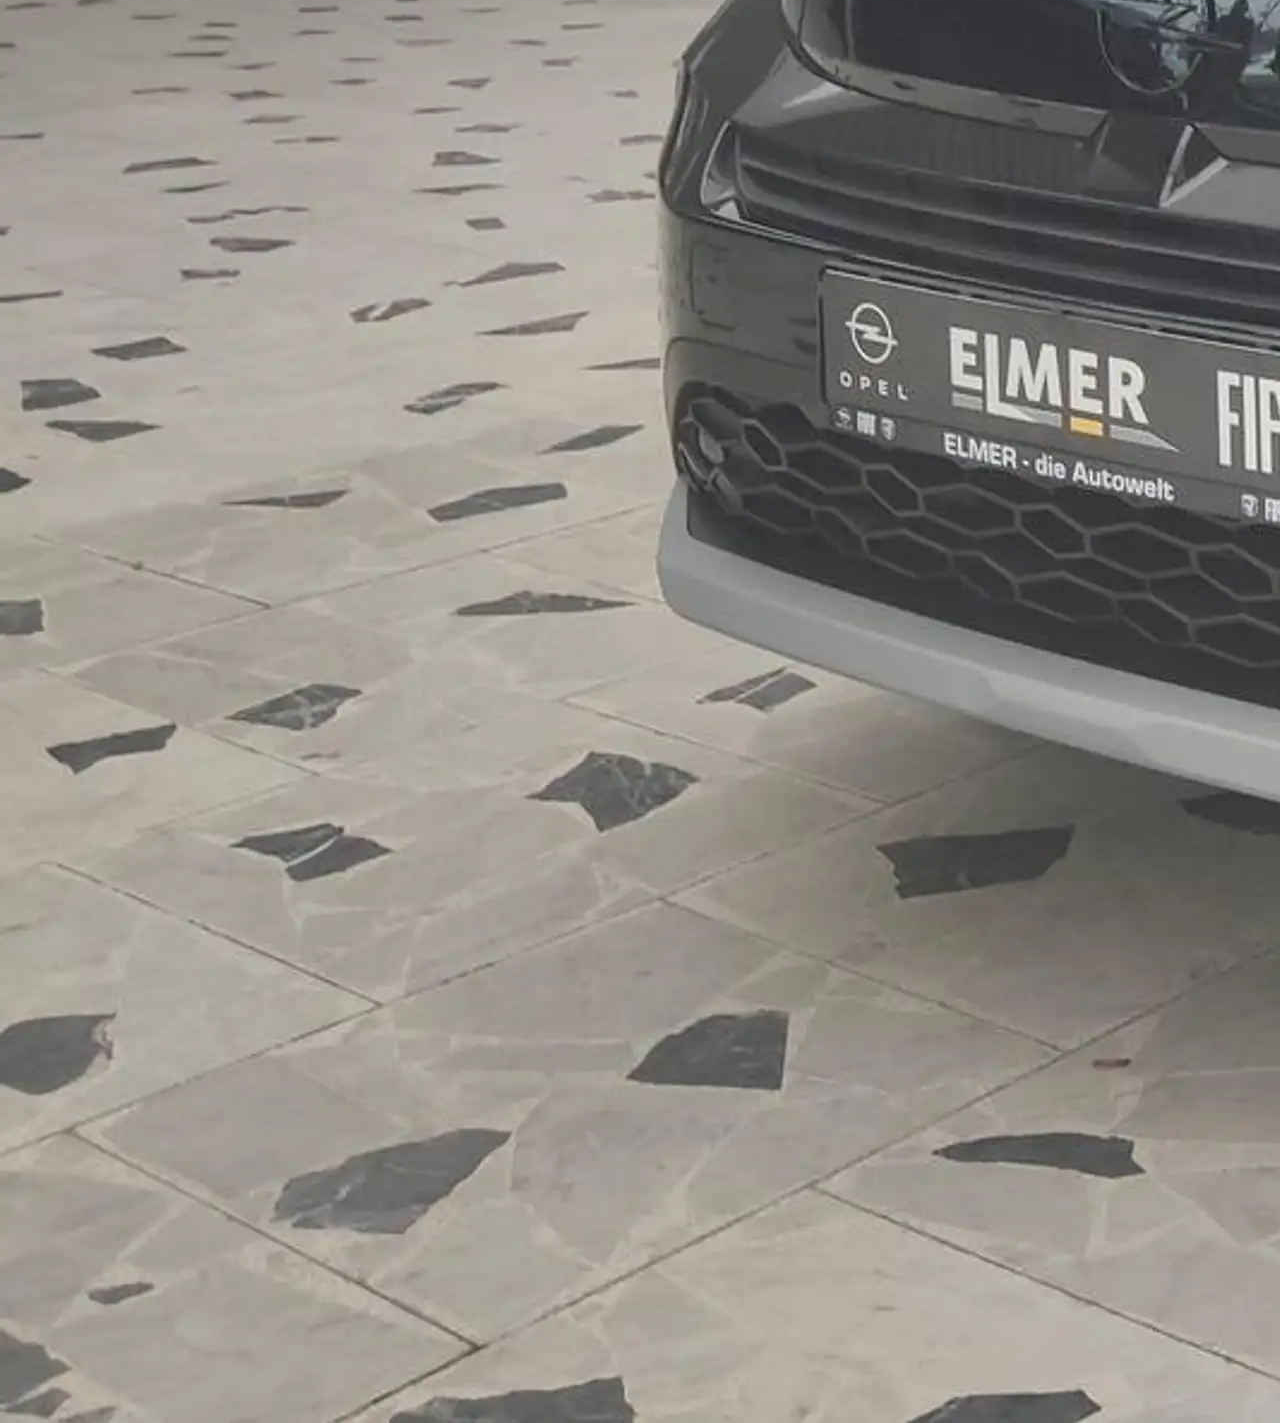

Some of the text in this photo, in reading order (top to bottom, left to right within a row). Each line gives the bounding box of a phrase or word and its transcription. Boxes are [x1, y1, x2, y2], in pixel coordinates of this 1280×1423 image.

[839, 370, 909, 402] OPEL
[949, 326, 1150, 425] ELMER
[943, 431, 1018, 470] ELMER
[1034, 453, 1067, 480] die
[1072, 461, 1175, 502] Autowelt
